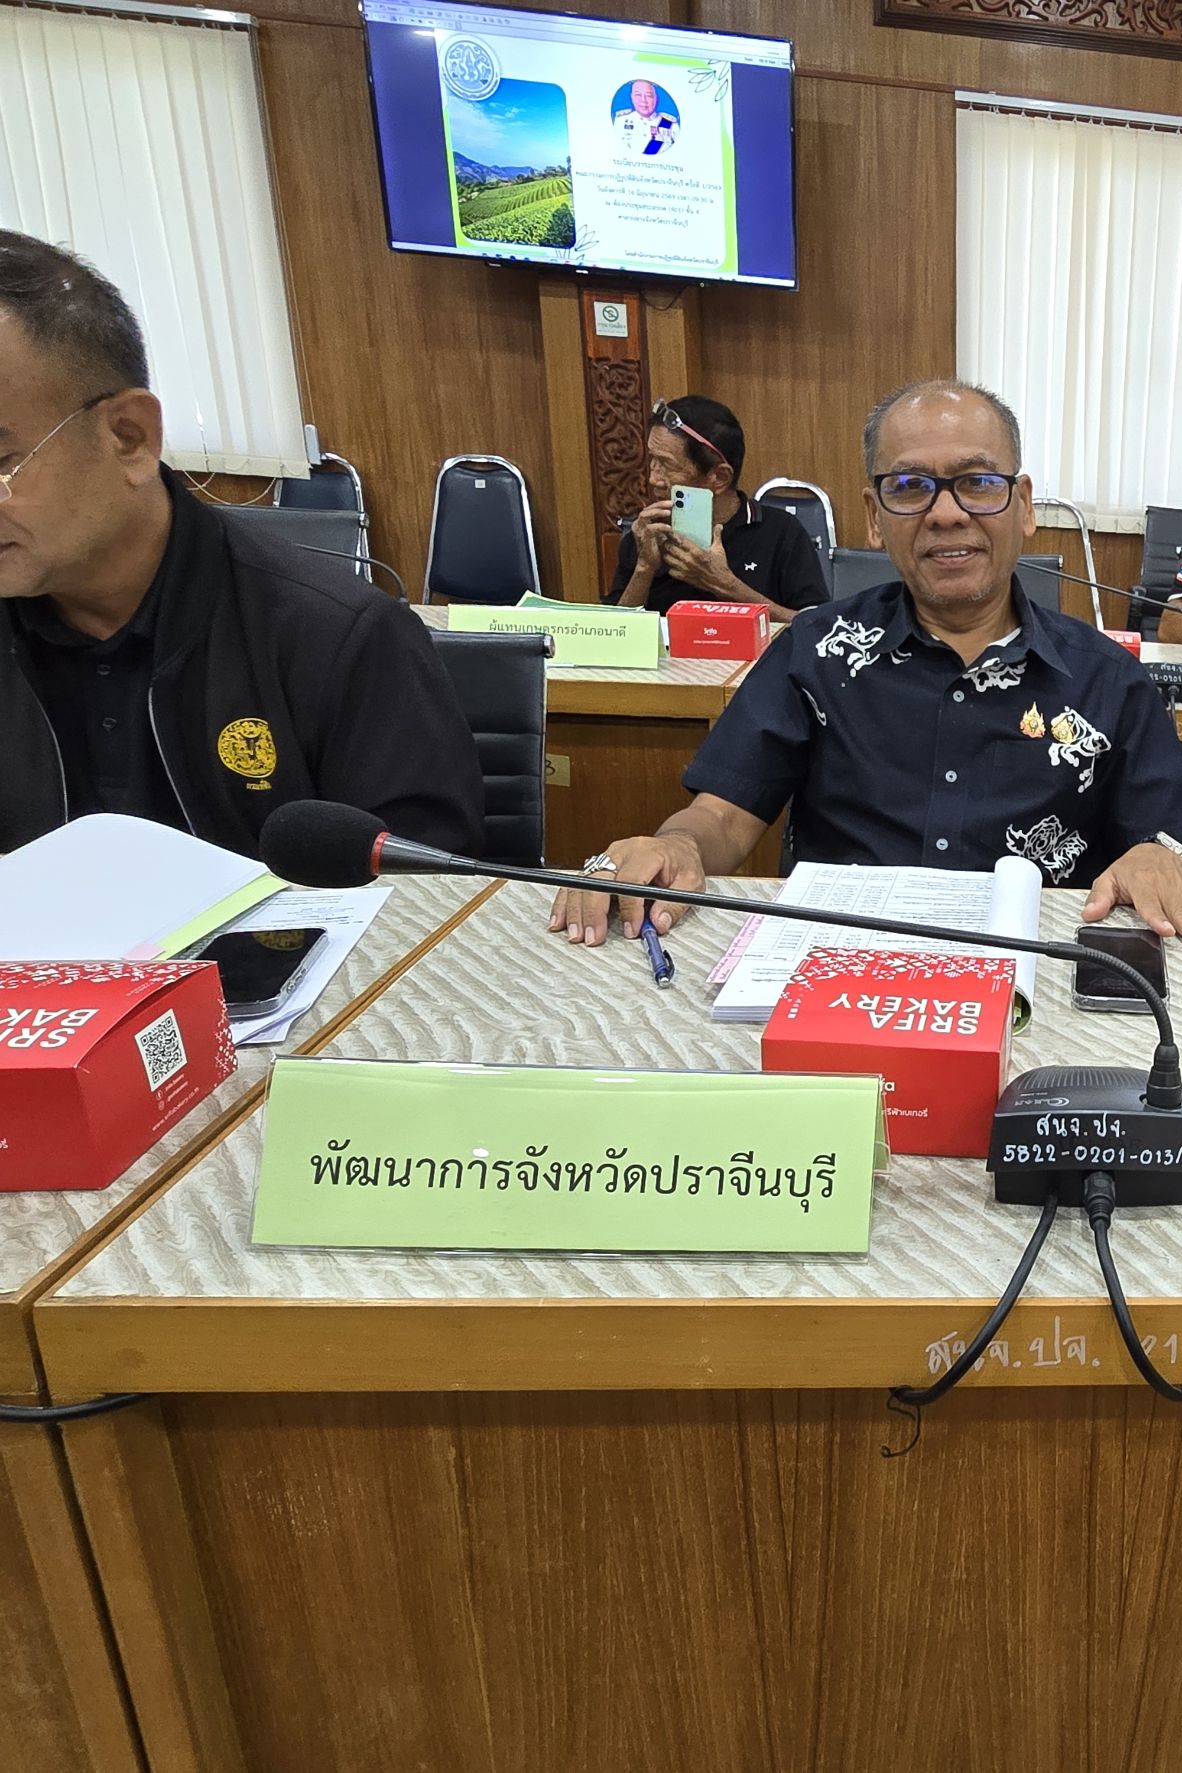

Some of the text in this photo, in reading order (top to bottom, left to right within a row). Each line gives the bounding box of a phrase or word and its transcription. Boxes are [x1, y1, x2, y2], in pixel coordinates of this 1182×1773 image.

[828, 993, 982, 1018] BAKERY
[868, 1011, 979, 1035] SRIFA
[310, 1139, 837, 1213] พัฒนาการจังหวัดปราจีนบุรี
